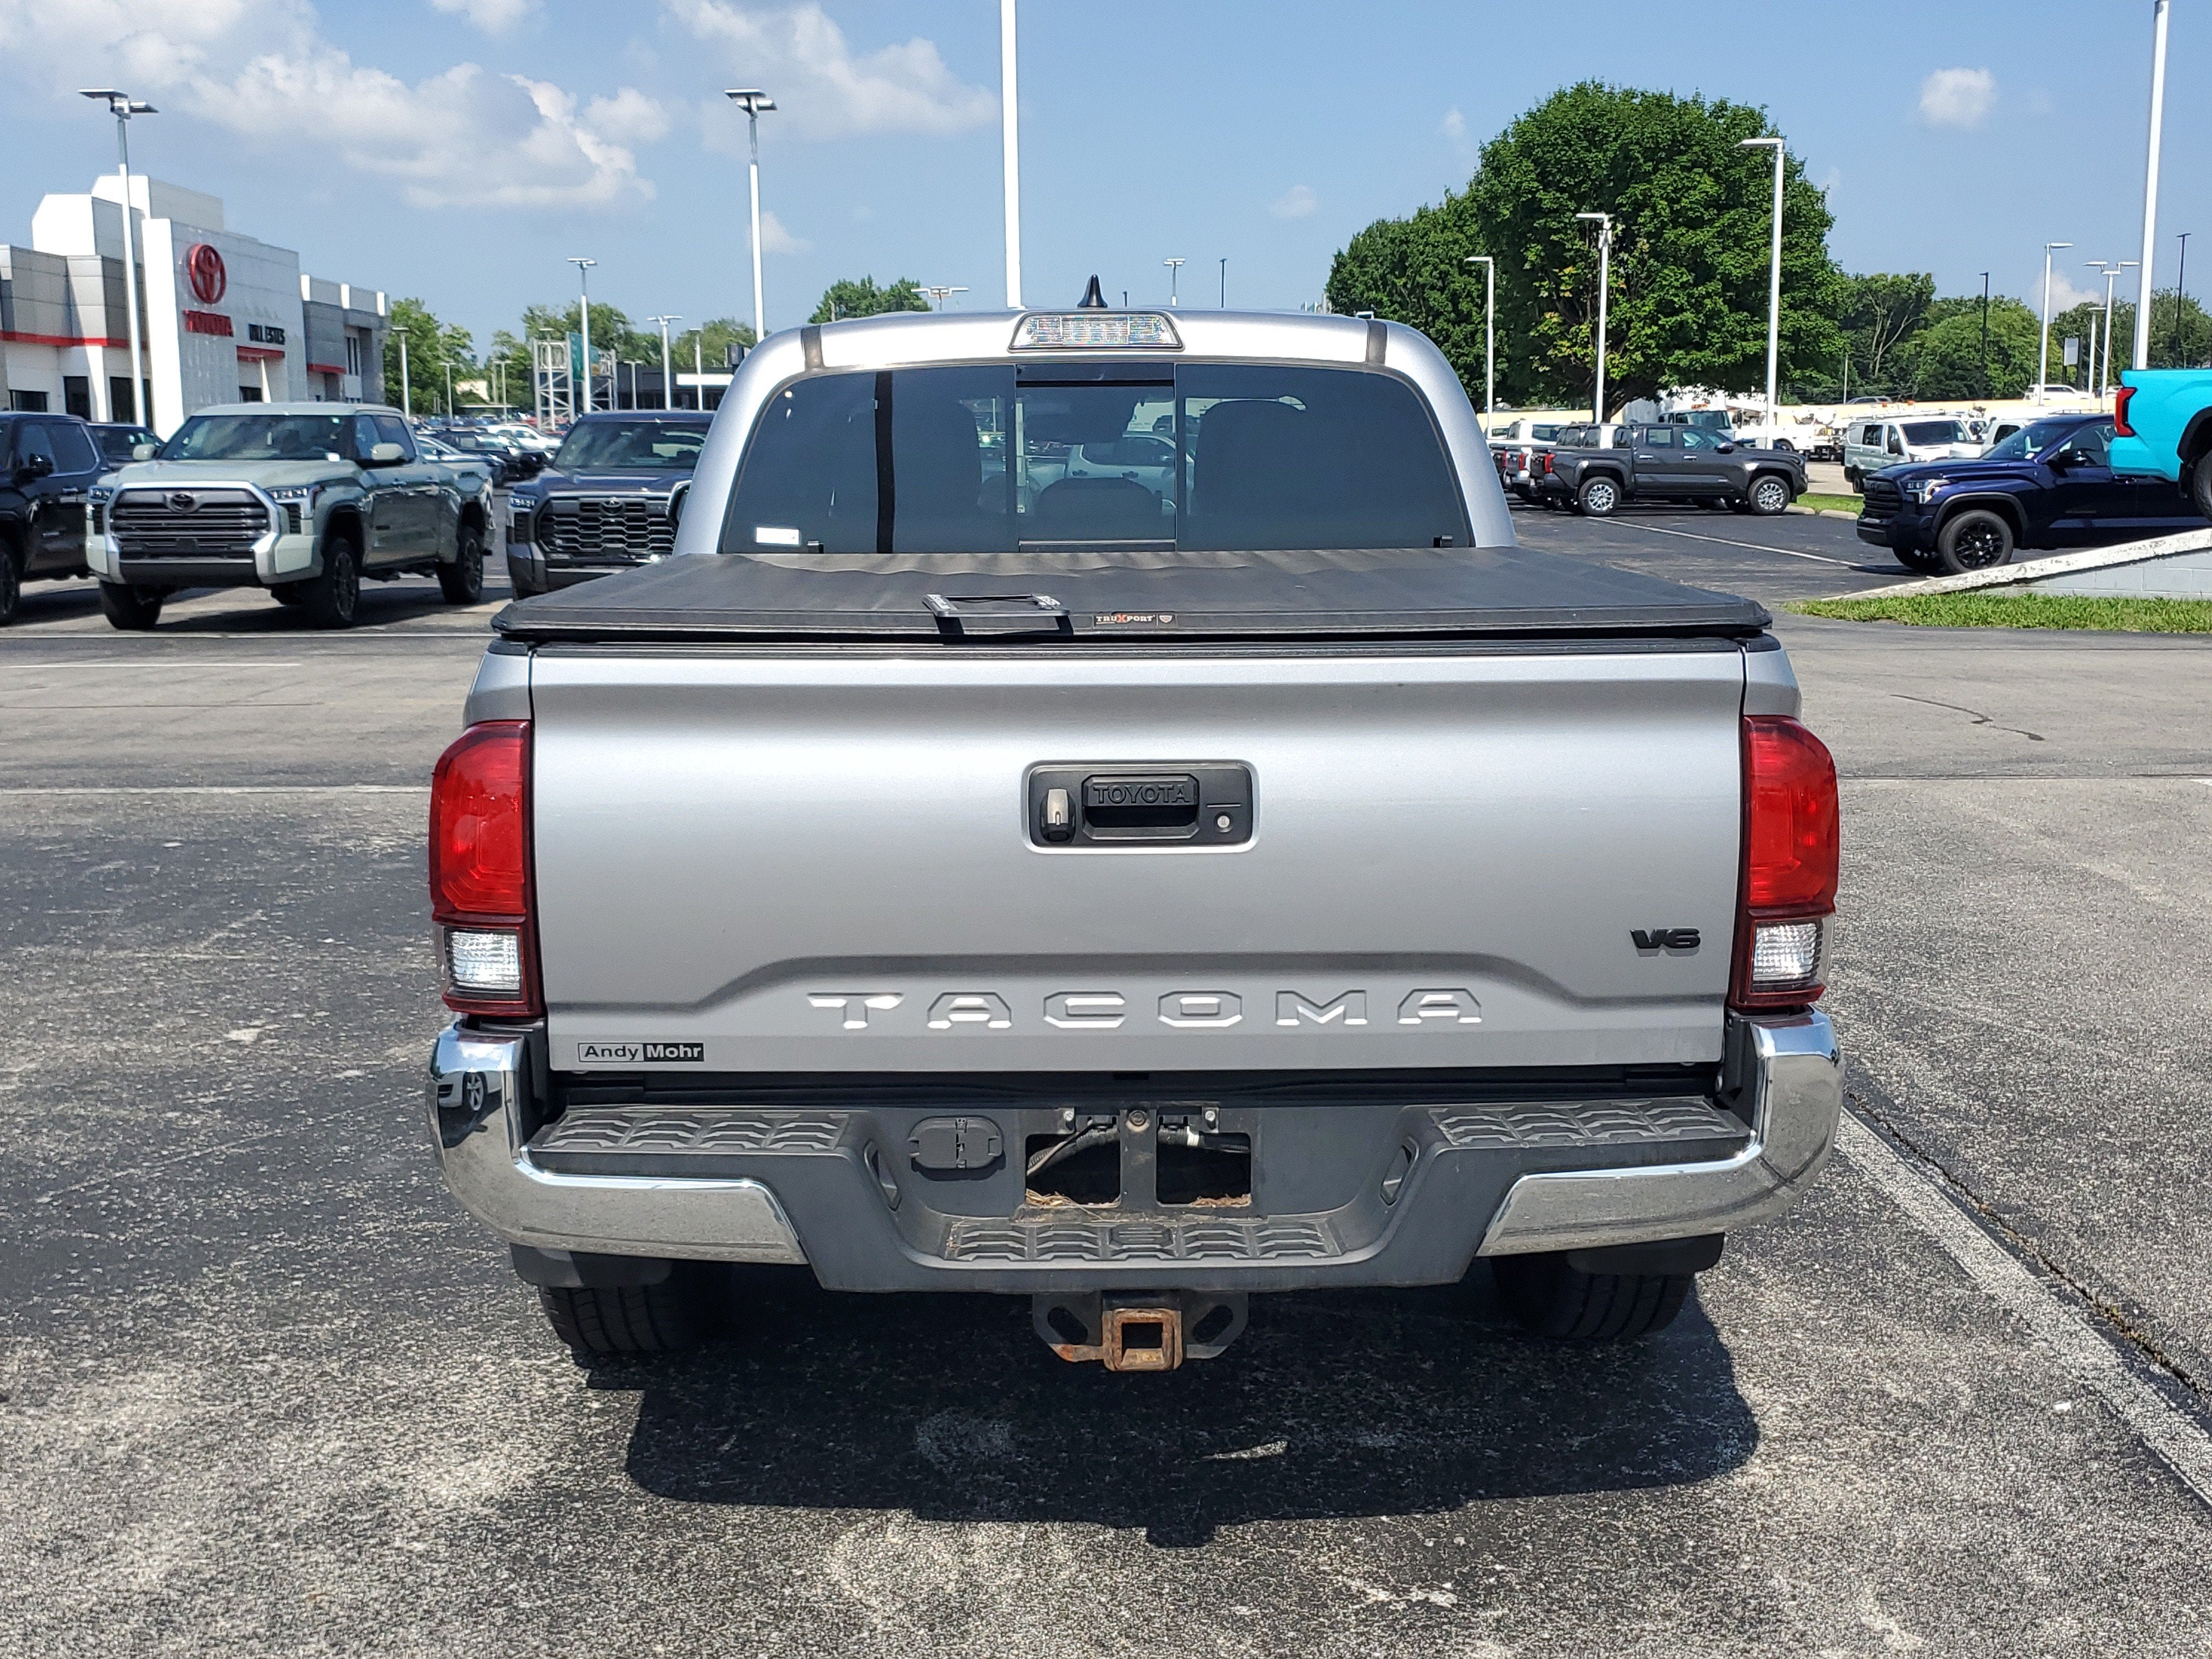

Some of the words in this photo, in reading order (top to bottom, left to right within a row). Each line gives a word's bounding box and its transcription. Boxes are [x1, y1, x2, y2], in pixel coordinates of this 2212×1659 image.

[1093, 785, 1190, 805] TOYOTA
[1630, 928, 1701, 949] V6
[808, 989, 1482, 1029] TACOMA
[584, 1045, 639, 1060] Andy
[646, 1045, 702, 1058] Mohr
